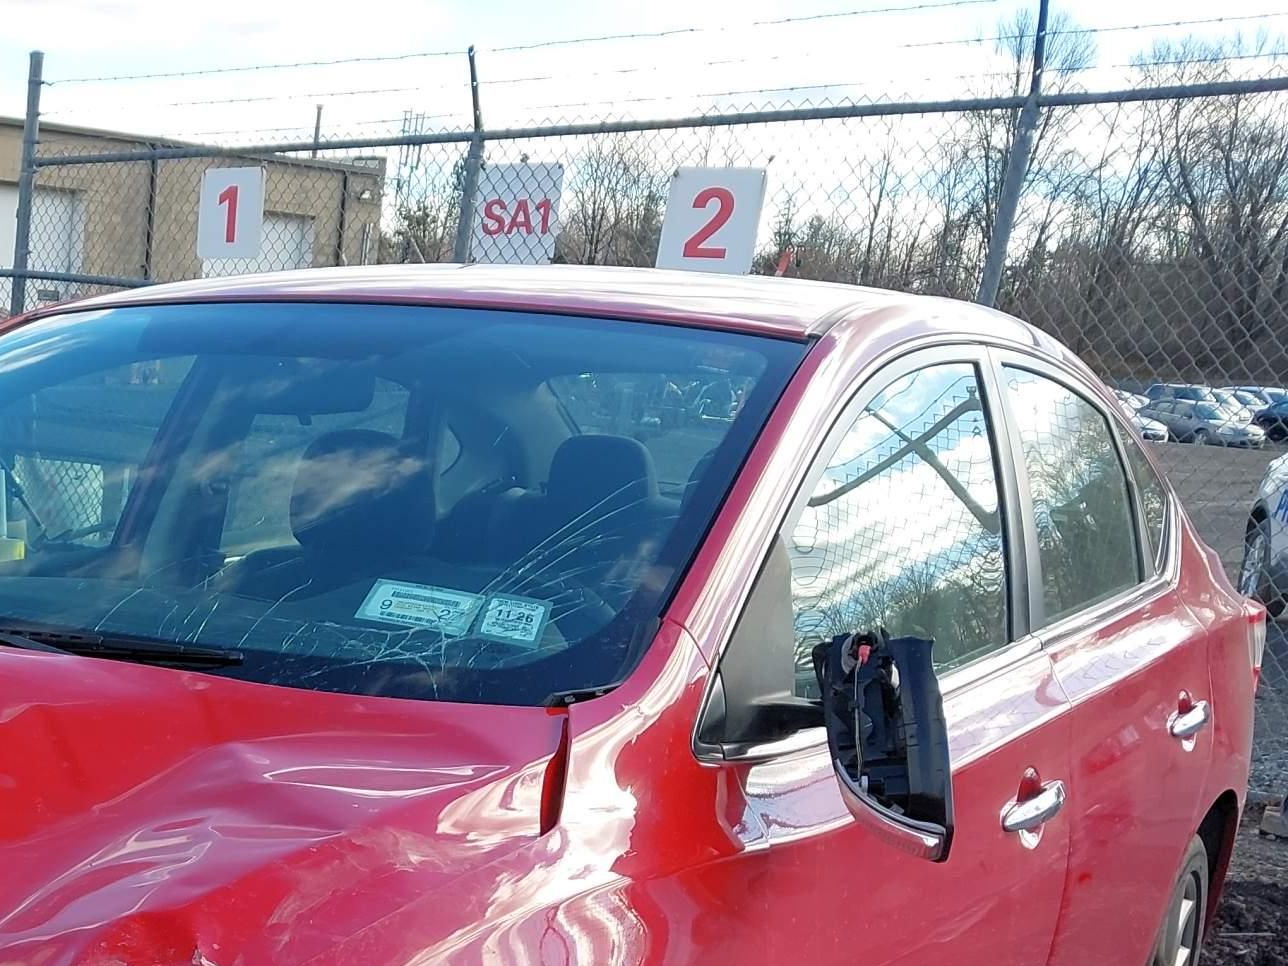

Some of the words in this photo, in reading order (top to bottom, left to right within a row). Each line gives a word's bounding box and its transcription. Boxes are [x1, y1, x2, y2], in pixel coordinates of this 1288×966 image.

[217, 185, 239, 243] 1
[481, 198, 552, 236] SA1
[682, 187, 736, 258] 2
